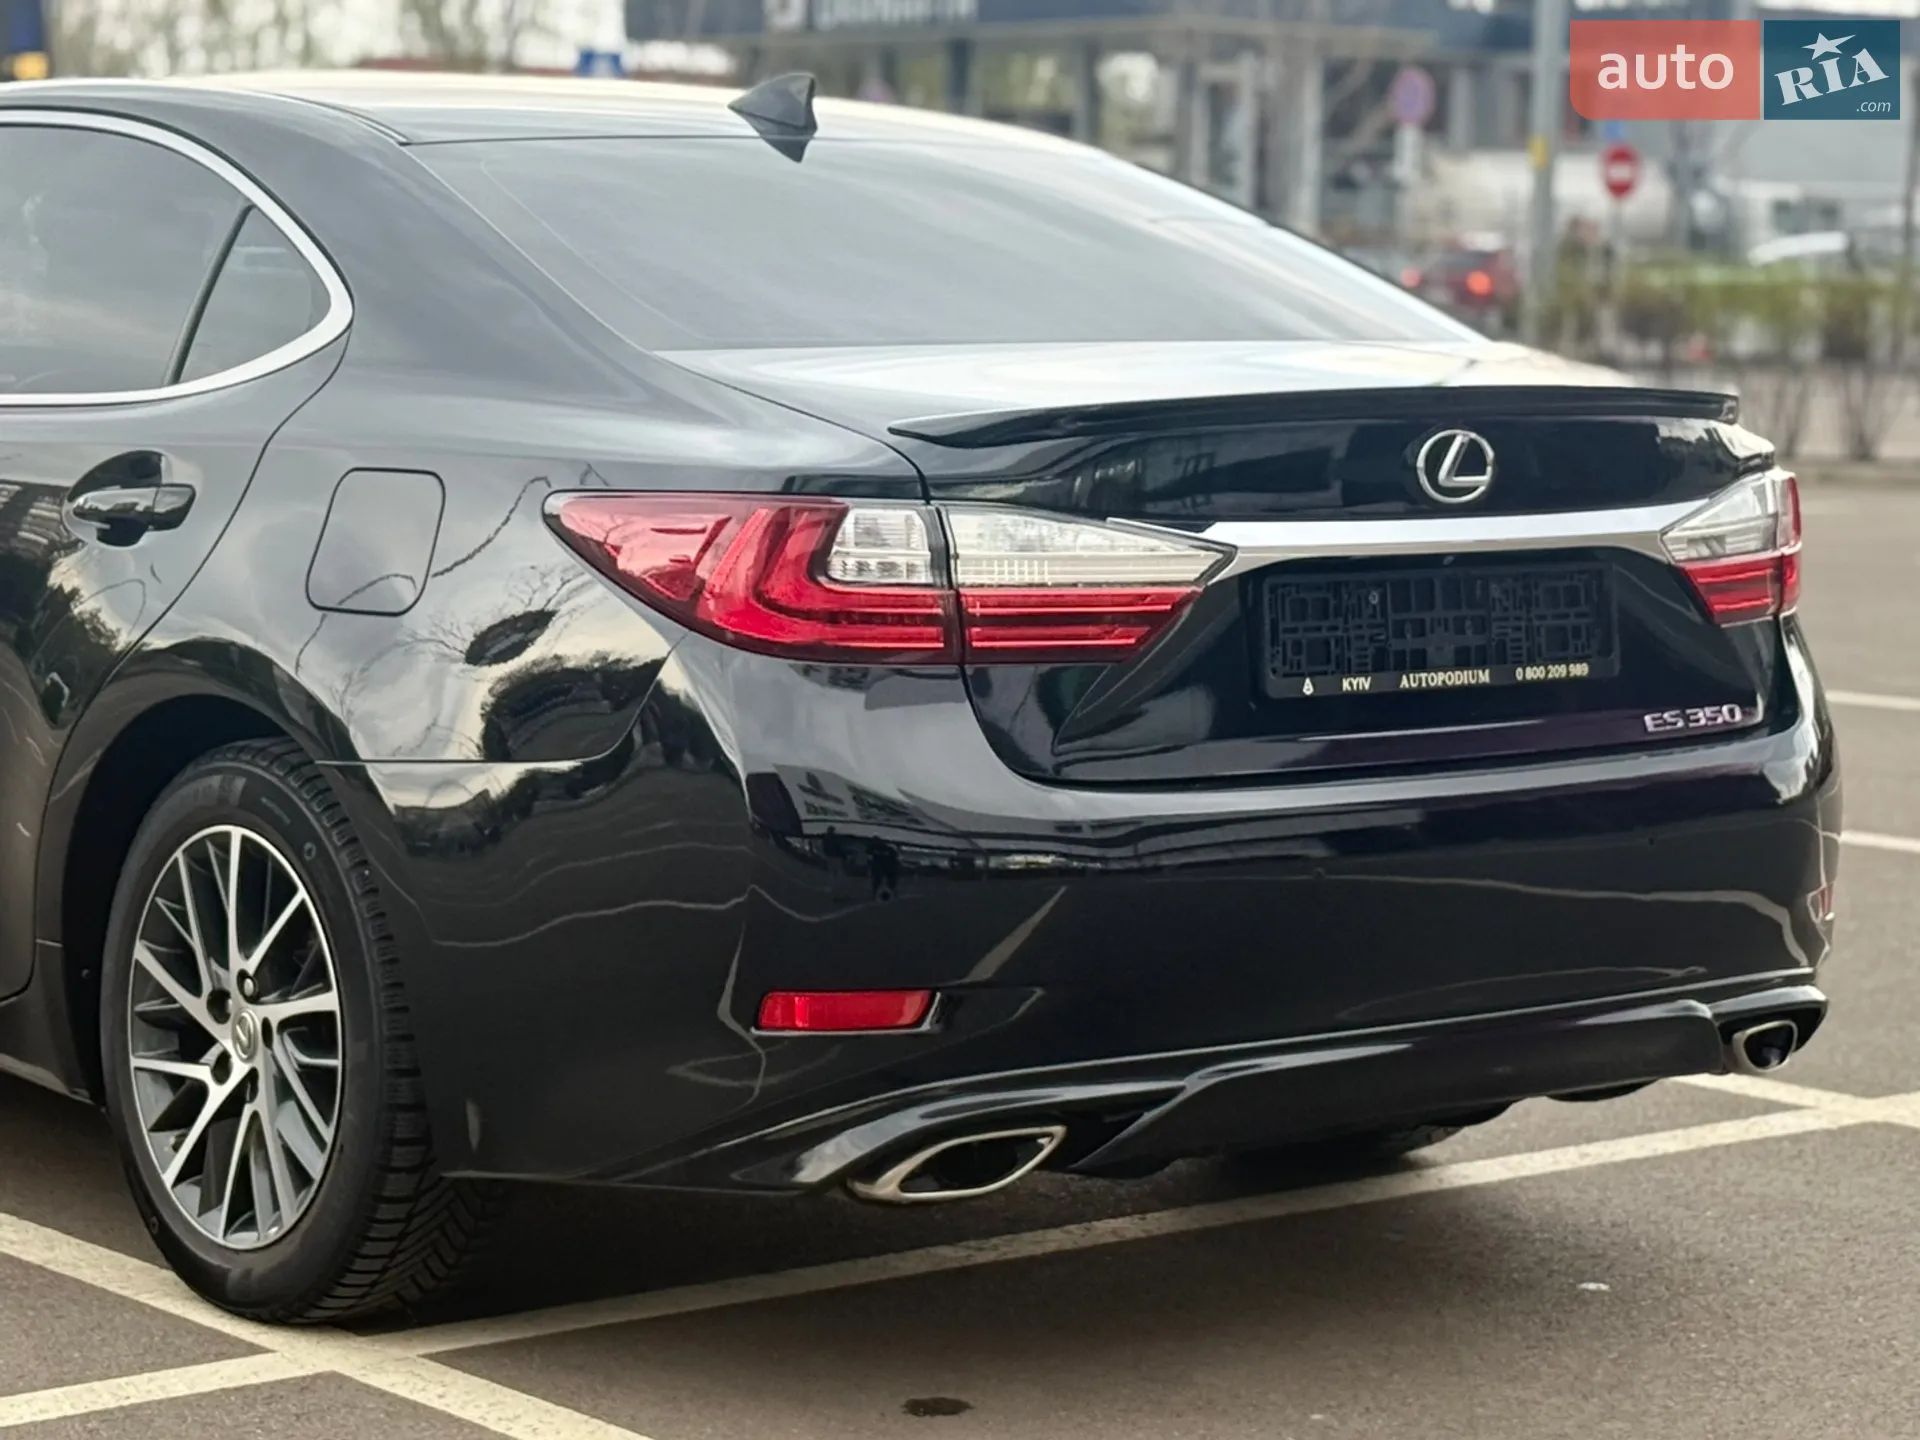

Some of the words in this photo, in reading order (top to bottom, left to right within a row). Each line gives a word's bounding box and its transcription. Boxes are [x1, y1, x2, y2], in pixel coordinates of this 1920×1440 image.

[1342, 676, 1371, 692] KYIV
[1400, 669, 1490, 689] AUTOPODIUM
[1515, 667, 1523, 681] 0
[1525, 665, 1545, 680] 800
[1547, 664, 1567, 679] 209
[1644, 710, 1684, 732] ES
[1685, 703, 1742, 728] 350
